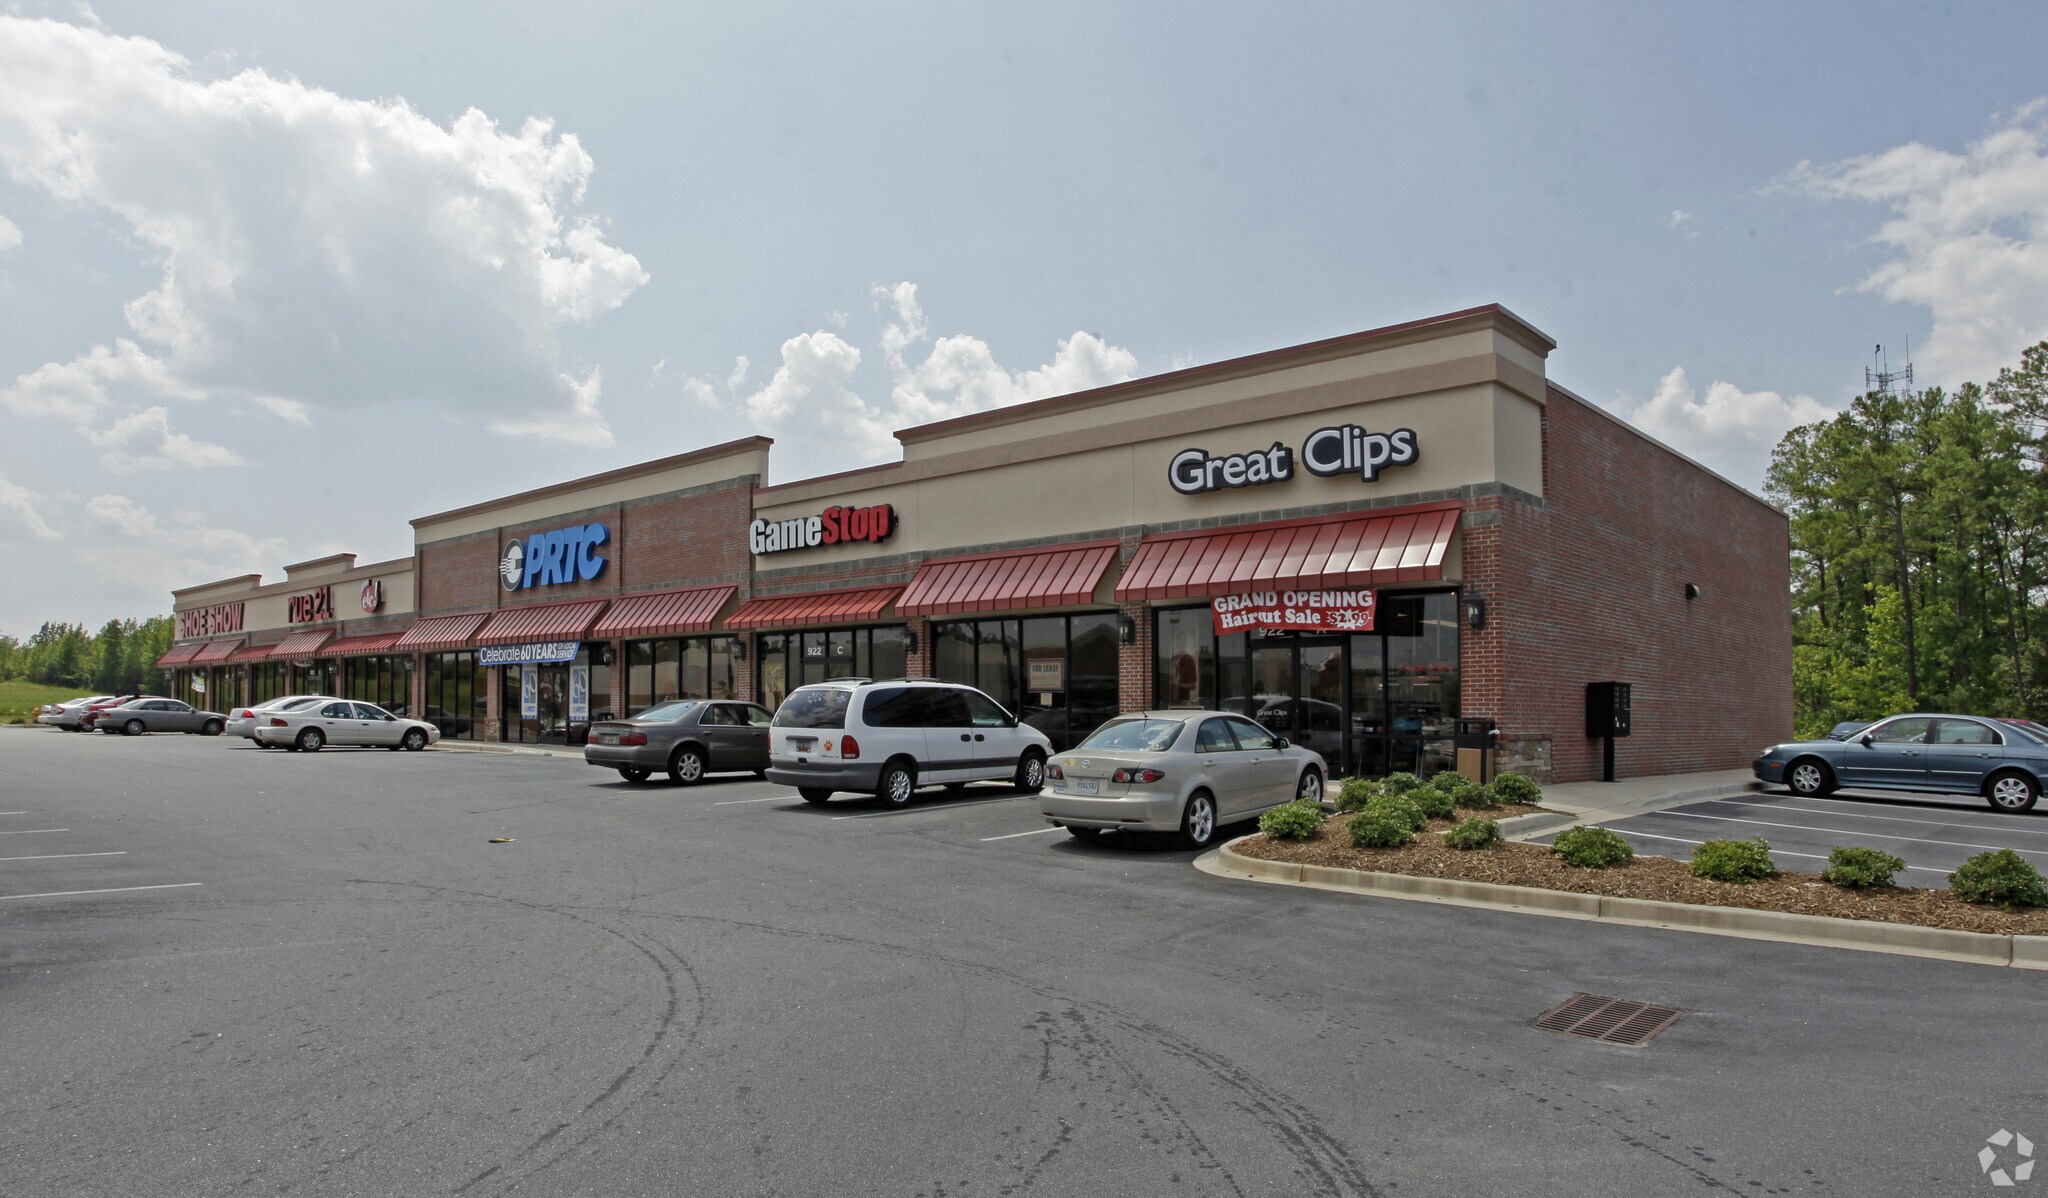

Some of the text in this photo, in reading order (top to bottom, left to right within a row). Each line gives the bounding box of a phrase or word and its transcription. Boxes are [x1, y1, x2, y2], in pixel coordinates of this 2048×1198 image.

[1170, 427, 1413, 492] Great Clips
[750, 503, 891, 555] GameStop
[523, 522, 608, 588] PRTC
[1214, 590, 1373, 613] GRAND OPENING
[180, 603, 245, 638] SHOE SHOW
[1285, 609, 1321, 624] Sale
[1328, 611, 1370, 625] $2.99
[480, 643, 557, 663] Celebrate 60 YEARS
[808, 645, 843, 656] 922 C
[1032, 664, 1059, 672] FOR LEASE
[1273, 708, 1288, 716] Clips
